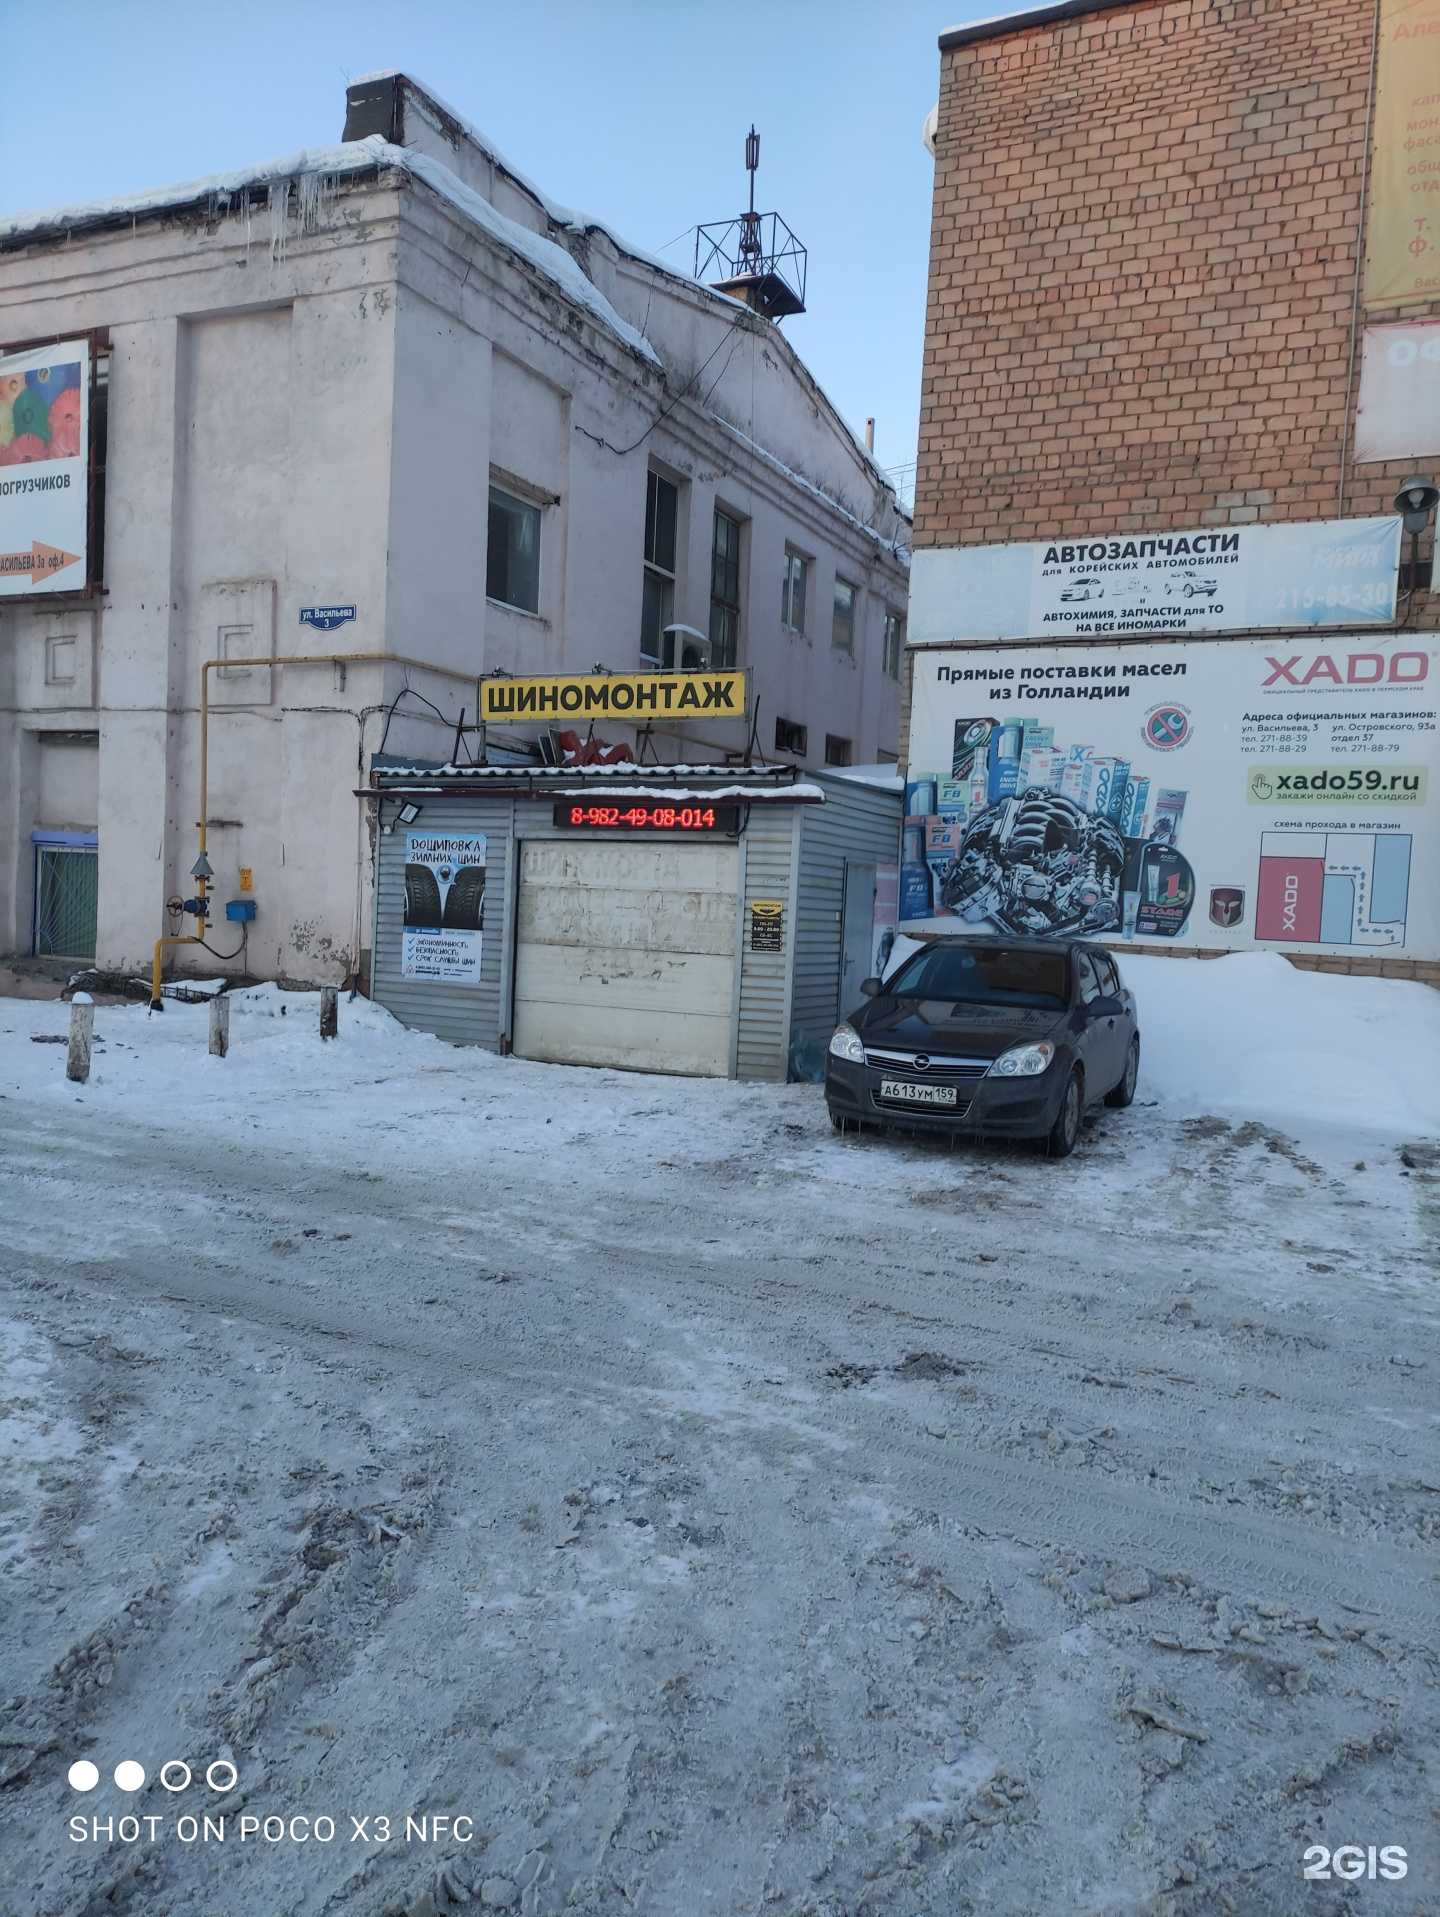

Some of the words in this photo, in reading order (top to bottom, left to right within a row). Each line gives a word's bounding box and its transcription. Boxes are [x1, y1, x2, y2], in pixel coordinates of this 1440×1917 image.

[1043, 533, 1240, 564] АВТОЗАПЧАСТИ
[1042, 569, 1062, 577] для
[1069, 561, 1139, 574] КОРЕЙСКИХ
[1146, 554, 1239, 568] АВТОМОБИЛЕЙ
[314, 609, 353, 618] Васильева
[1043, 610, 1118, 622] АВТОХИМИЯ,
[1120, 606, 1181, 618] ЗАПЧАСТИ
[1184, 607, 1205, 616] для
[1208, 604, 1224, 614] ТО
[324, 619, 330, 628] 3
[1076, 622, 1092, 632] НА
[1095, 621, 1115, 632] ВСЕ
[1117, 619, 1186, 631] ИНОМАРКИ
[937, 667, 1015, 684] Прямые
[1020, 664, 1116, 679] поставки
[1122, 662, 1187, 677] масел
[1261, 652, 1429, 686] XADO
[488, 680, 735, 713] ШИНОМОНТАЖ
[989, 687, 1011, 699] из
[1017, 684, 1130, 700] Голландии
[1242, 712, 1283, 723] Адреса
[1286, 712, 1367, 722] официальных
[1370, 711, 1437, 719] магазинов:
[1257, 724, 1310, 732] Васильева,
[1312, 723, 1319, 731] 3
[1348, 723, 1415, 732] Островского,
[1276, 769, 1419, 791] xado59.ru
[1316, 792, 1355, 800] онлайн
[1372, 791, 1416, 801] скидкой
[571, 807, 715, 828] 8-982-49-08-014
[1274, 821, 1302, 829] схема
[1305, 821, 1347, 830] прохода
[1359, 822, 1401, 830] магазин
[411, 838, 481, 852] ДОШИПОВКА
[410, 852, 452, 863] ЗИМНИХ
[458, 854, 480, 864] ШИН
[1282, 875, 1298, 932] XADO
